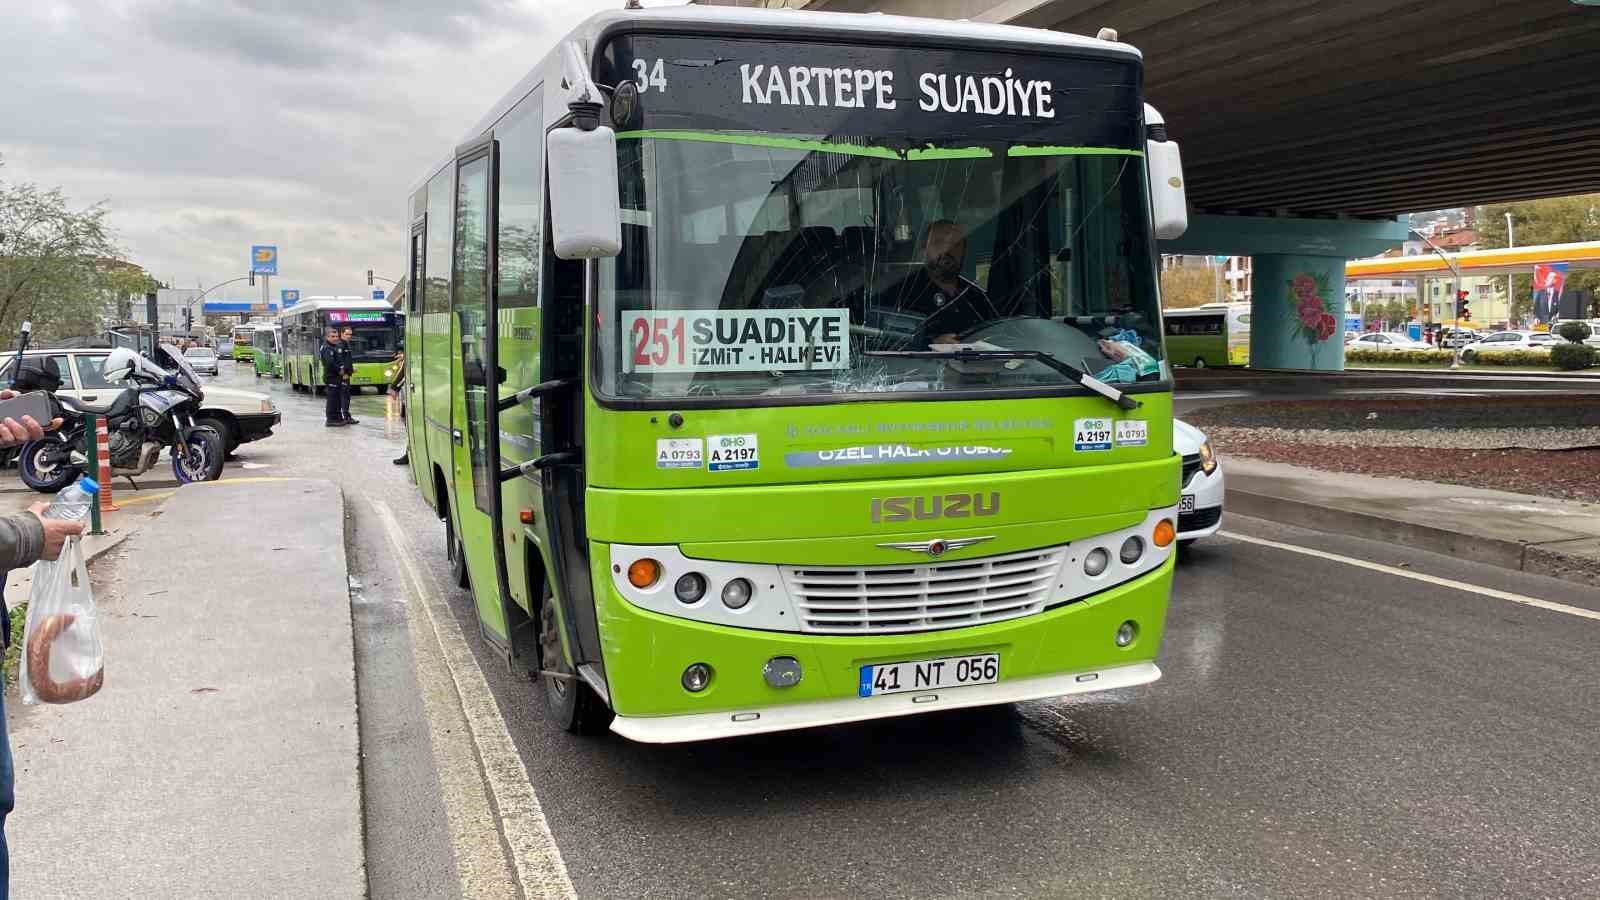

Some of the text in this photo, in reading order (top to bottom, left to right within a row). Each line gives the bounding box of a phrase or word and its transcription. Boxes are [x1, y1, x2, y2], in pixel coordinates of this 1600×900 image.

[631, 58, 667, 93] 34
[740, 63, 897, 110] KARTEPE
[632, 317, 686, 366] 251
[1076, 431, 1110, 442] A 2197
[1117, 429, 1145, 438] A 0793
[659, 450, 700, 459] A 0793
[711, 448, 756, 461] A 2197
[871, 491, 1001, 524] ISUZU
[874, 666, 900, 690] 41
[914, 662, 945, 687] NT
[956, 657, 997, 682] 056
